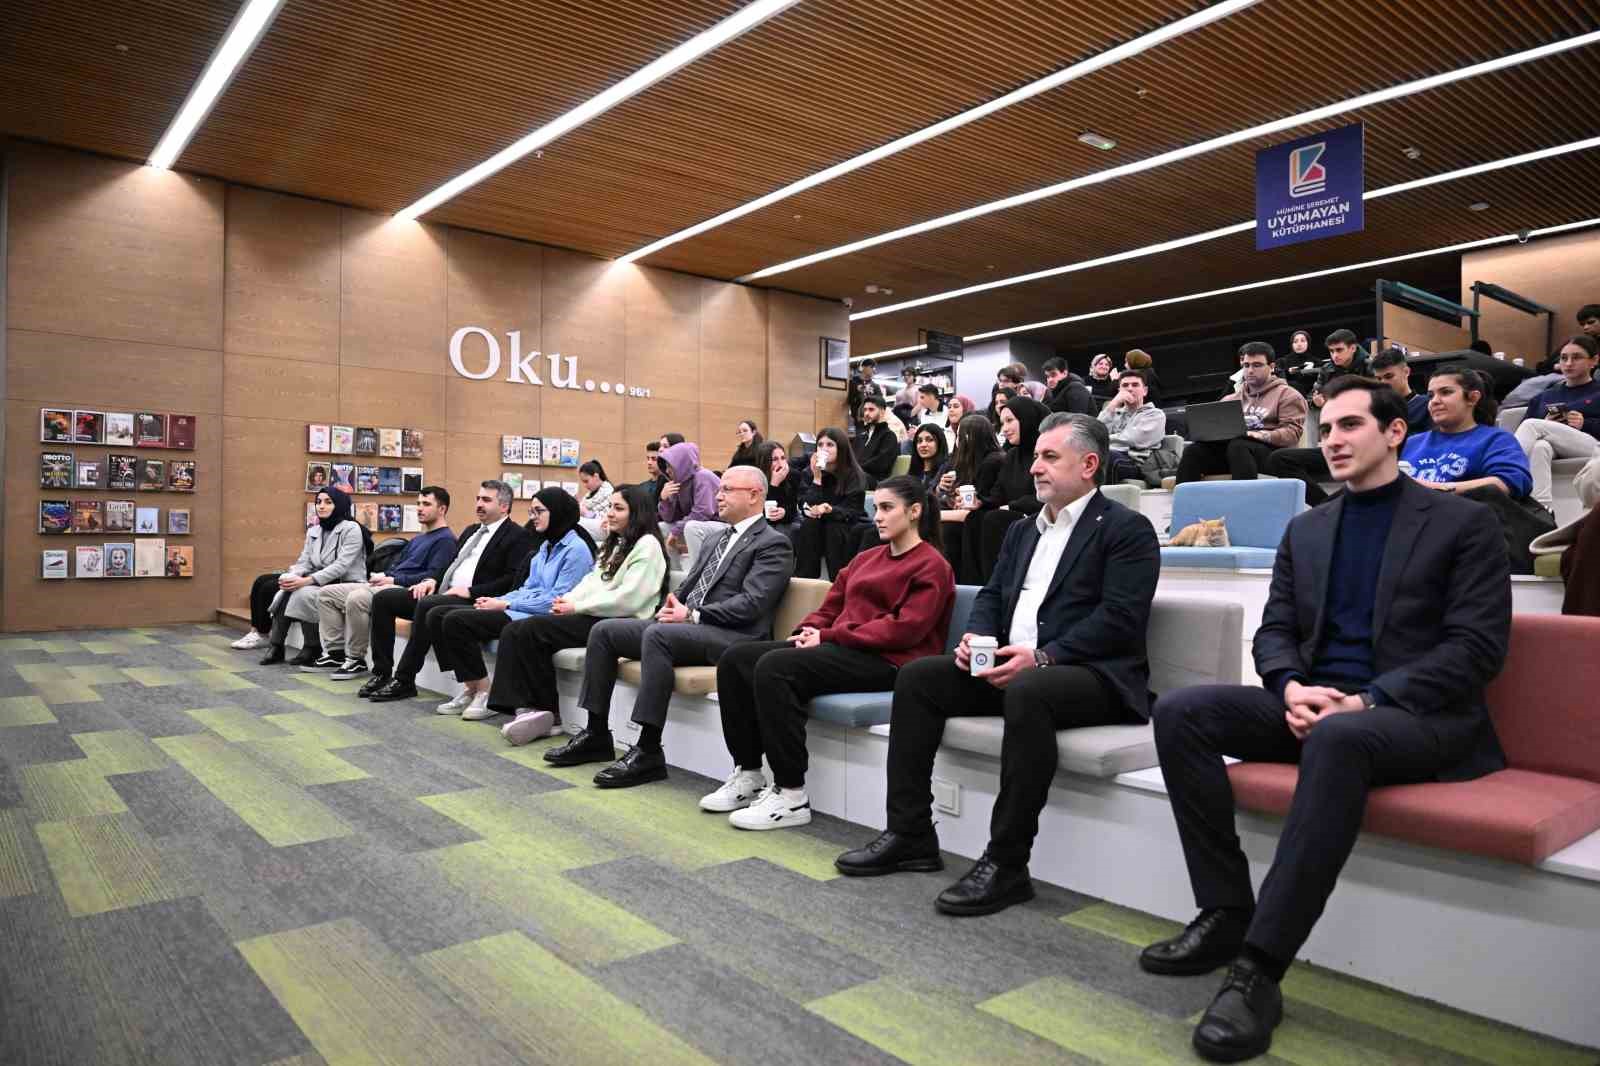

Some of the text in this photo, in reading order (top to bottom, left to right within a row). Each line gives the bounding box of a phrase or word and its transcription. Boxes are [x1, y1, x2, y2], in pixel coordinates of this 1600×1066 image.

[1267, 201, 1350, 229] UYUMAYAN
[1272, 214, 1345, 238] KÜTÜPHANESİ
[448, 326, 625, 395] Oku...
